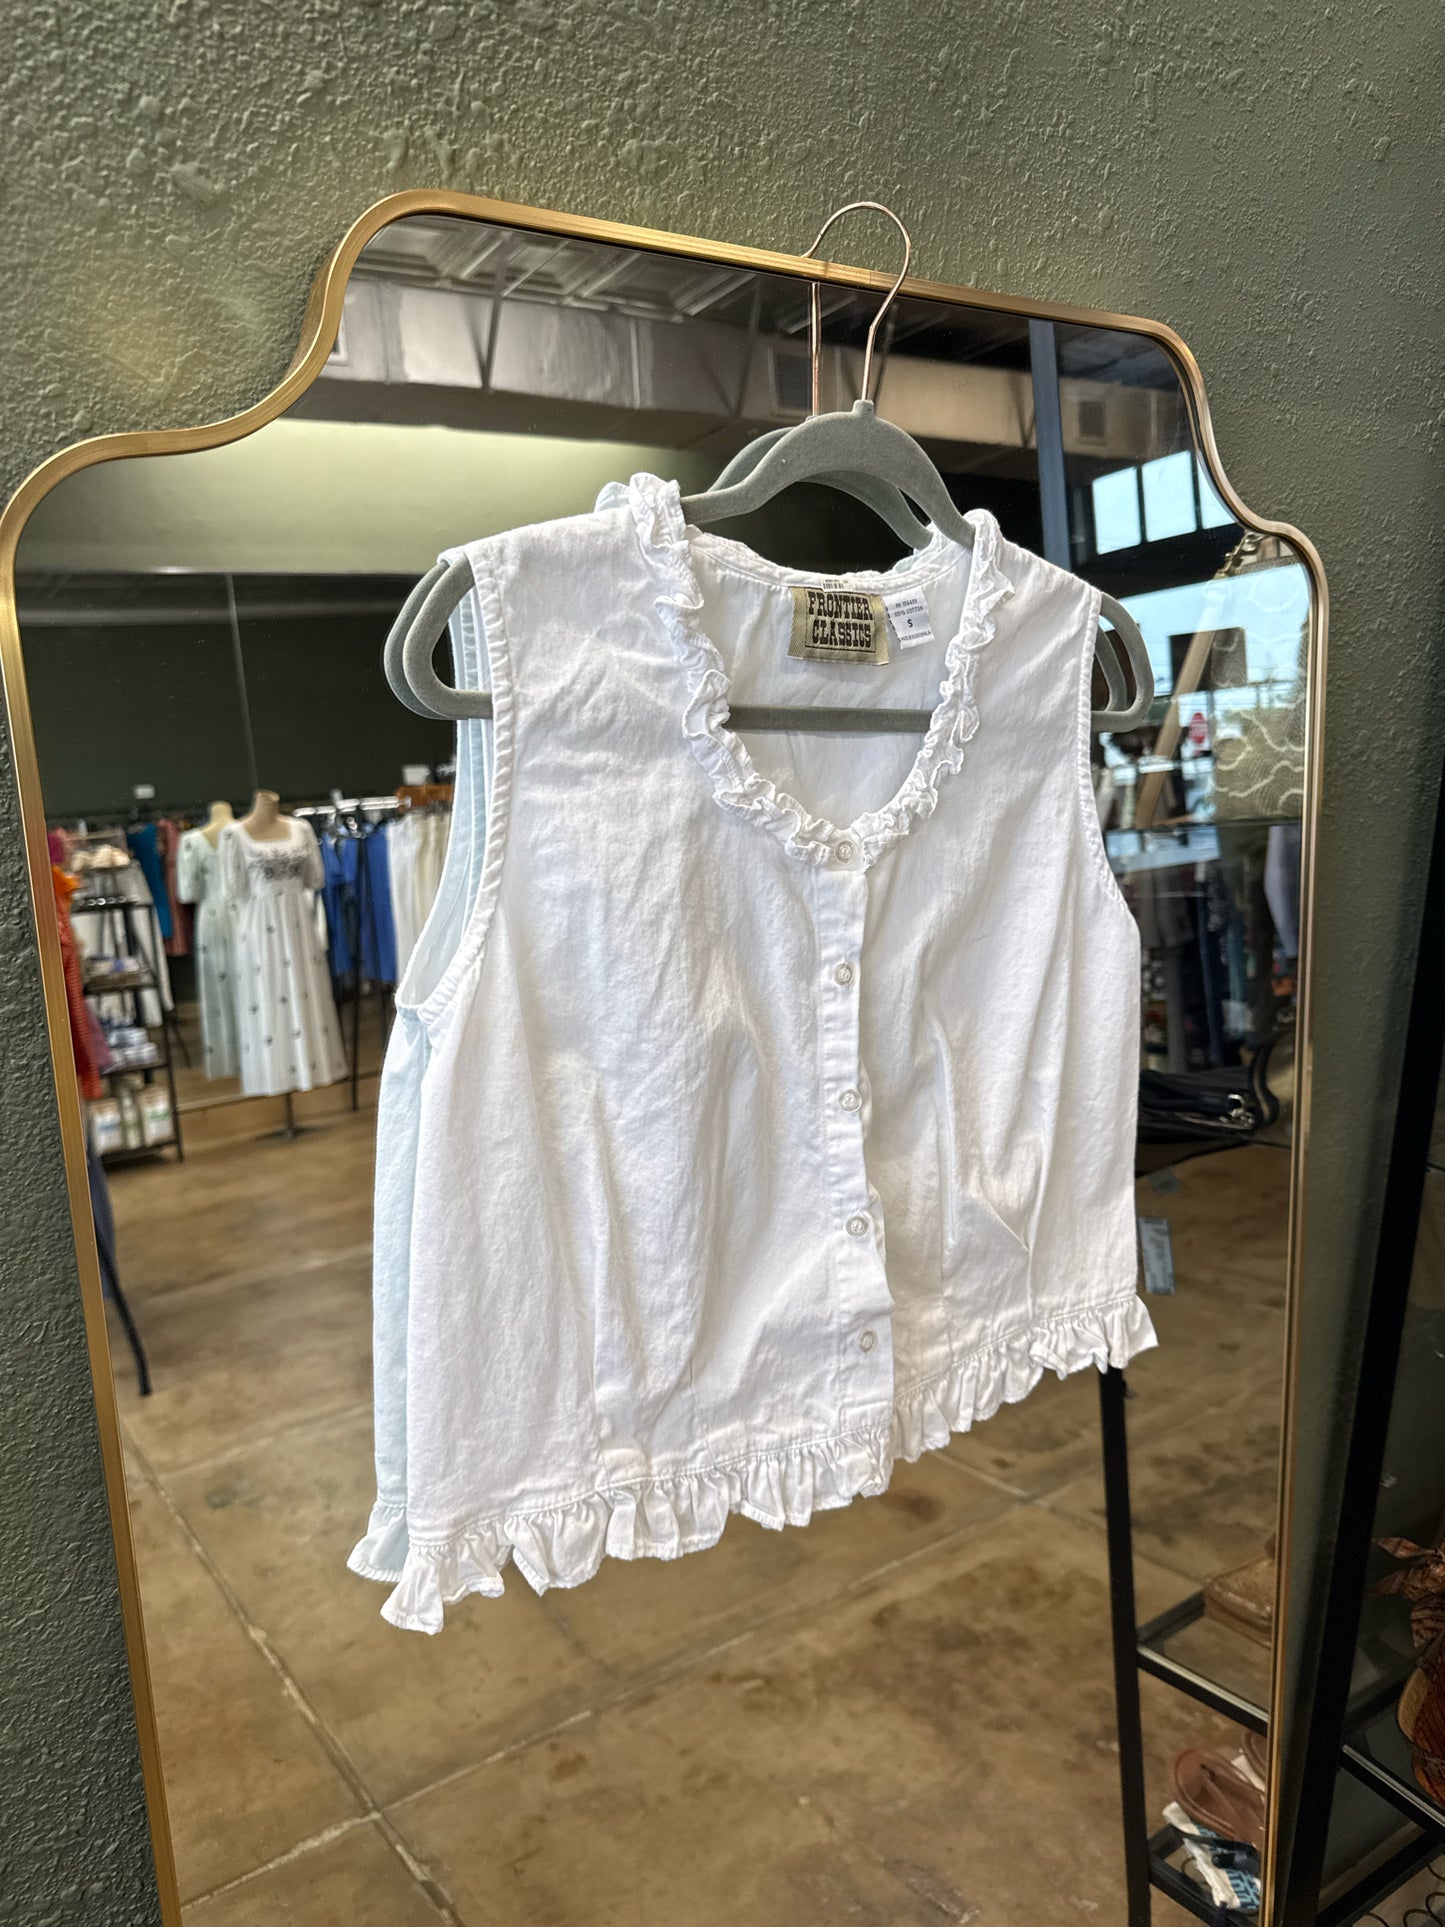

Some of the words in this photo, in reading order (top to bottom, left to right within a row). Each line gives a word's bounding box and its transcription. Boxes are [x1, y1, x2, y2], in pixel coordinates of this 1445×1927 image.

[807, 590, 873, 621] FRONTIER
[811, 618, 872, 648] CLASSICS
[907, 618, 914, 628] S
